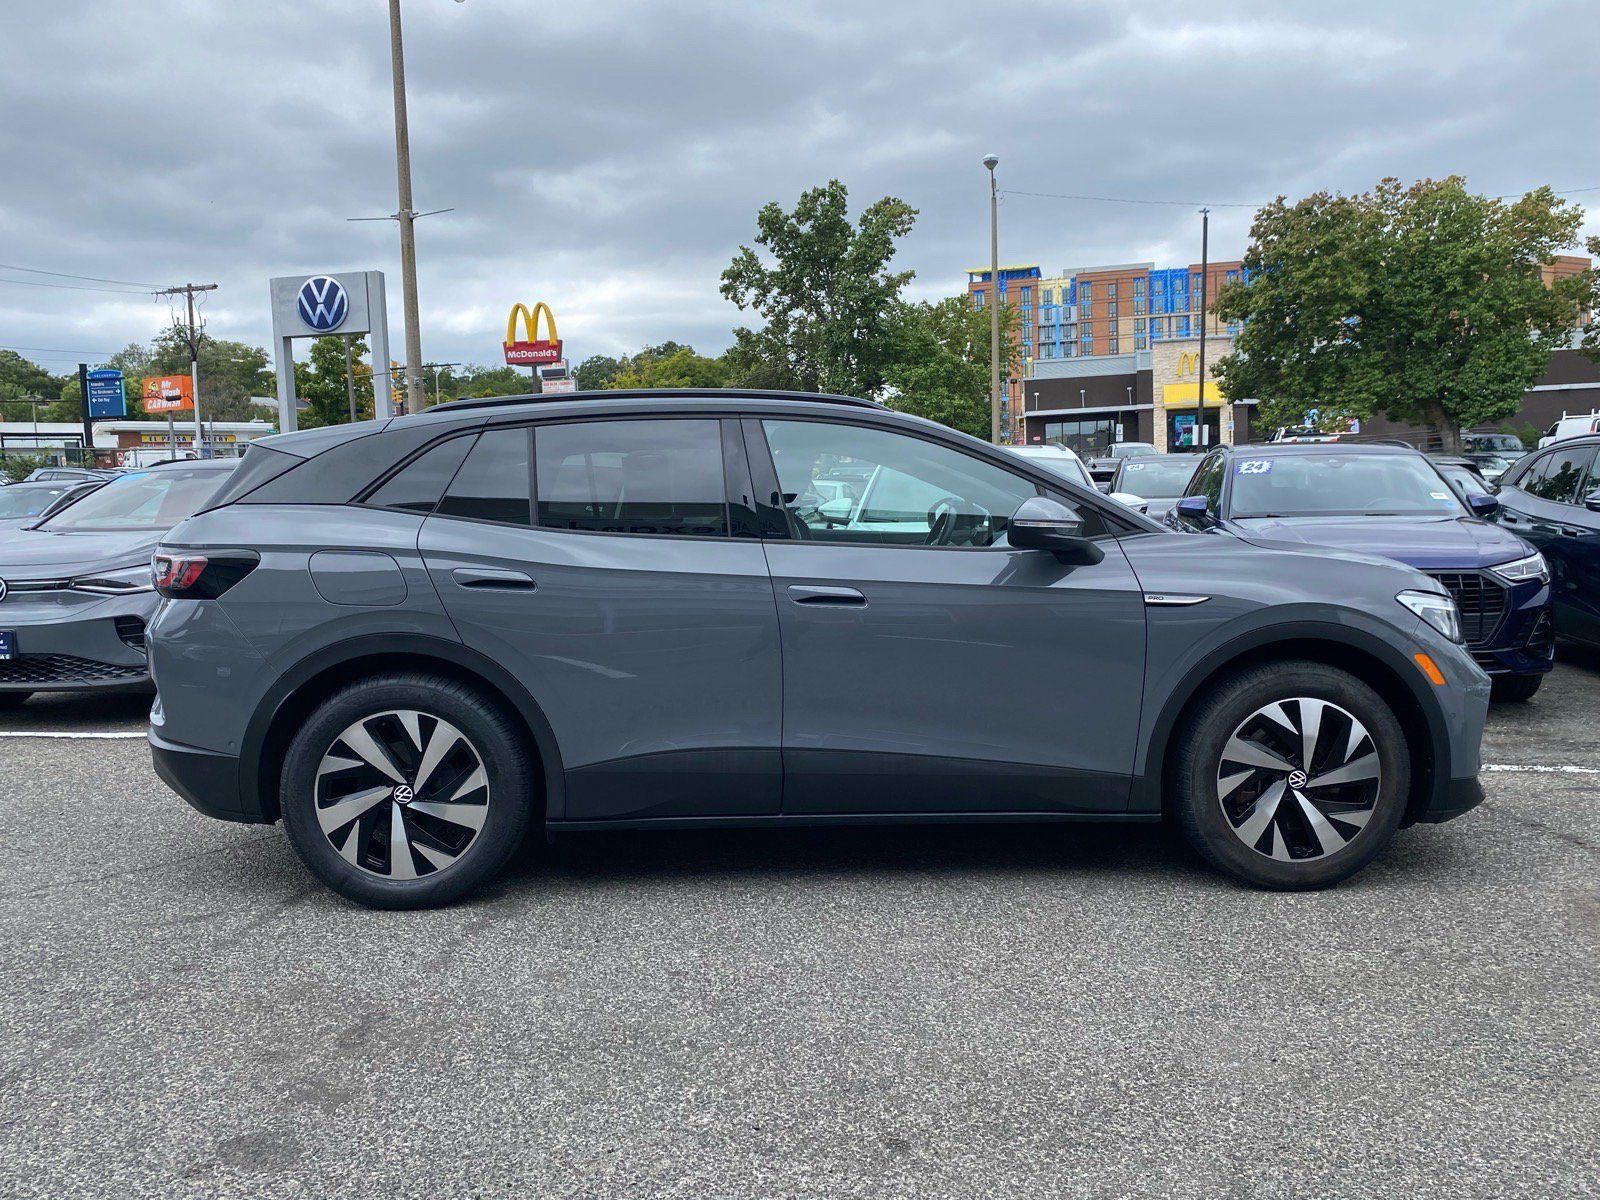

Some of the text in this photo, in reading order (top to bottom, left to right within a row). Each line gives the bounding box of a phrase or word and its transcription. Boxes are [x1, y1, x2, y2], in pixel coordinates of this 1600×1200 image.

[507, 350, 557, 358] McDonald's
[161, 381, 172, 390] Mr
[1244, 462, 1264, 471] 24
